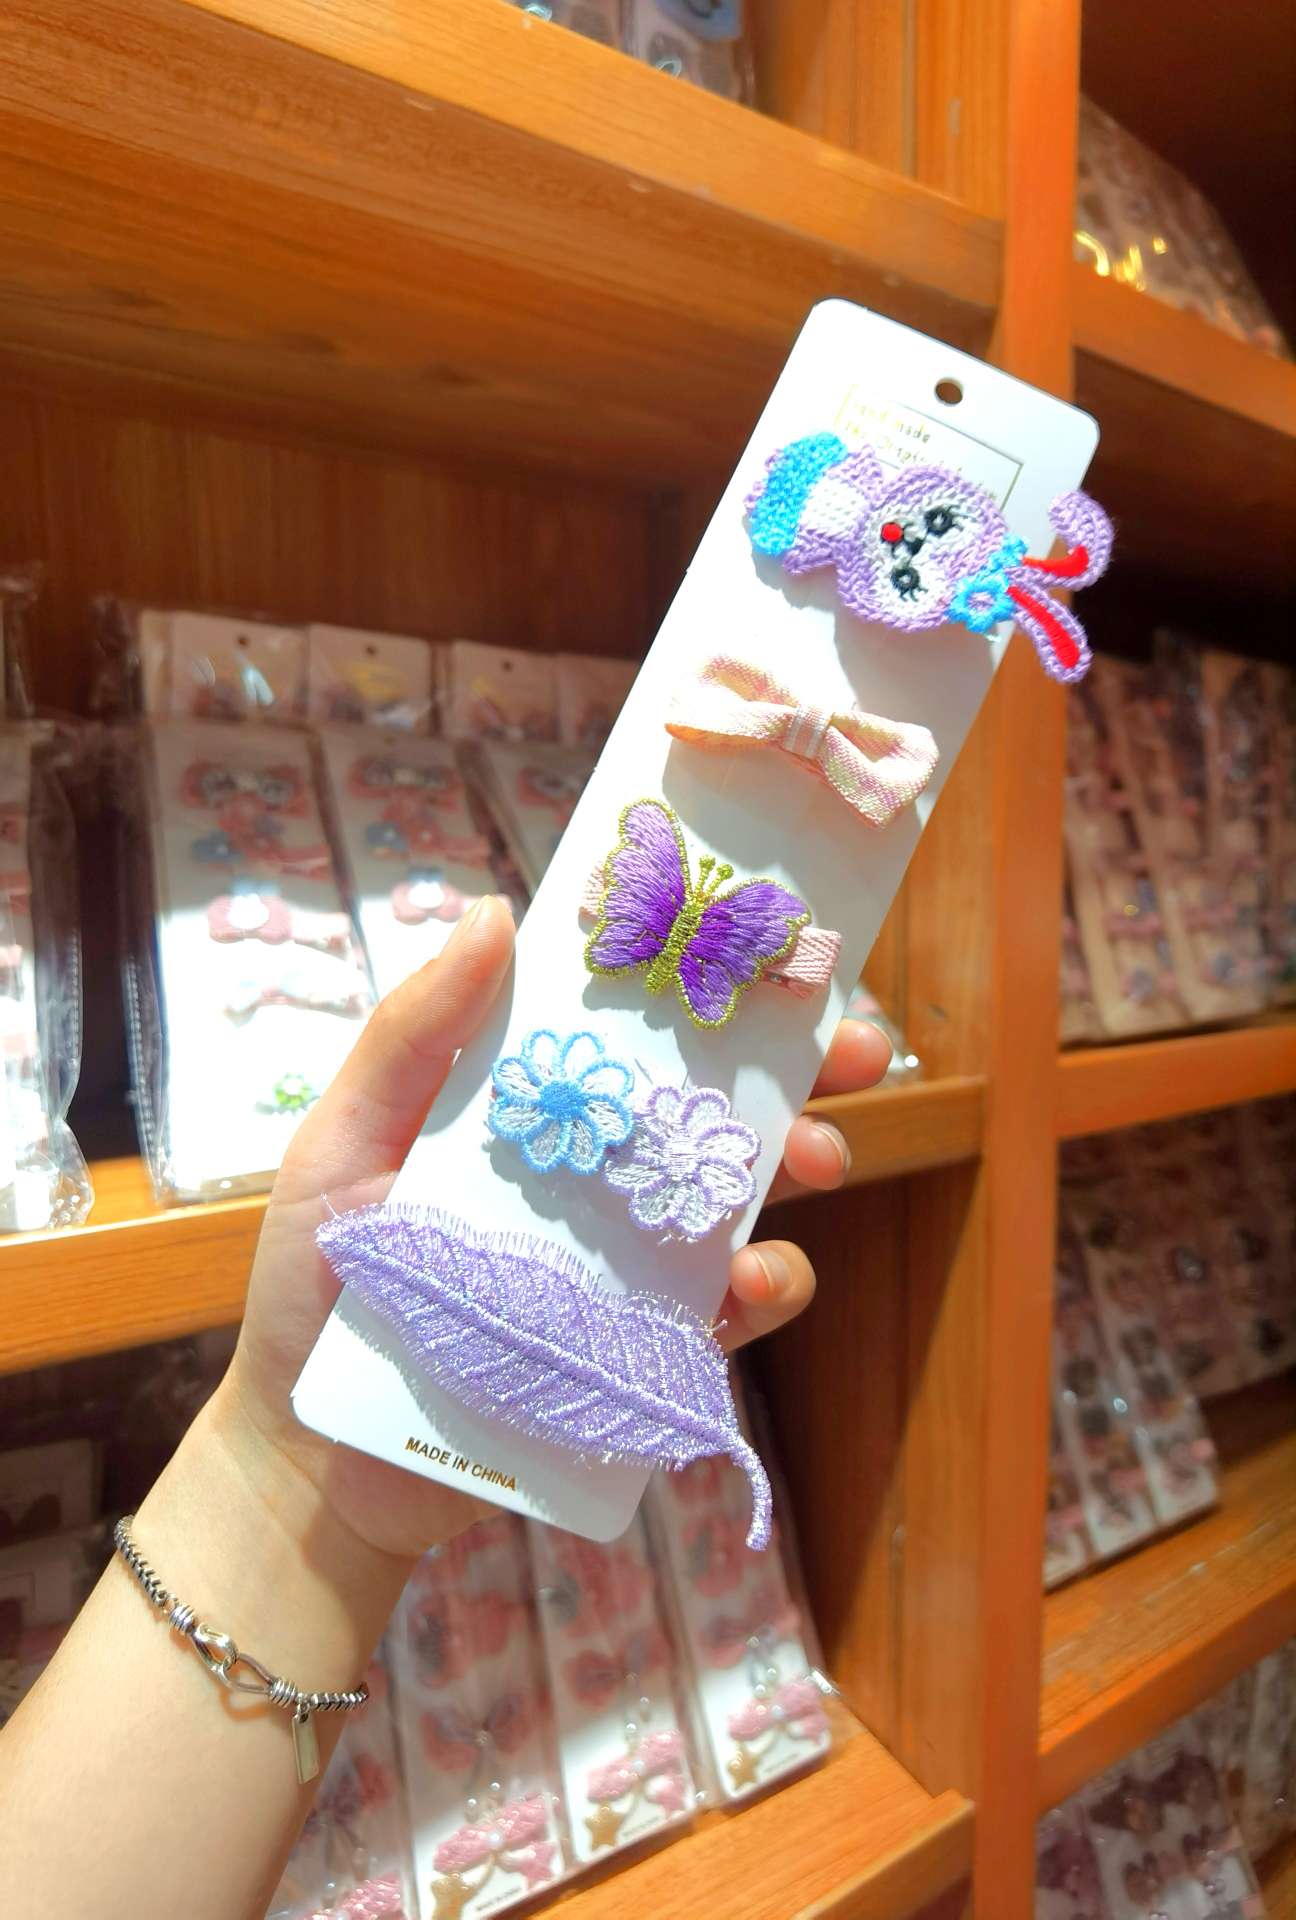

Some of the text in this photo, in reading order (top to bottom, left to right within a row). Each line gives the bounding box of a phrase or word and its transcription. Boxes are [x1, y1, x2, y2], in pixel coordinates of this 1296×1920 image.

[405, 1437, 516, 1490] MADE IN CHINA
